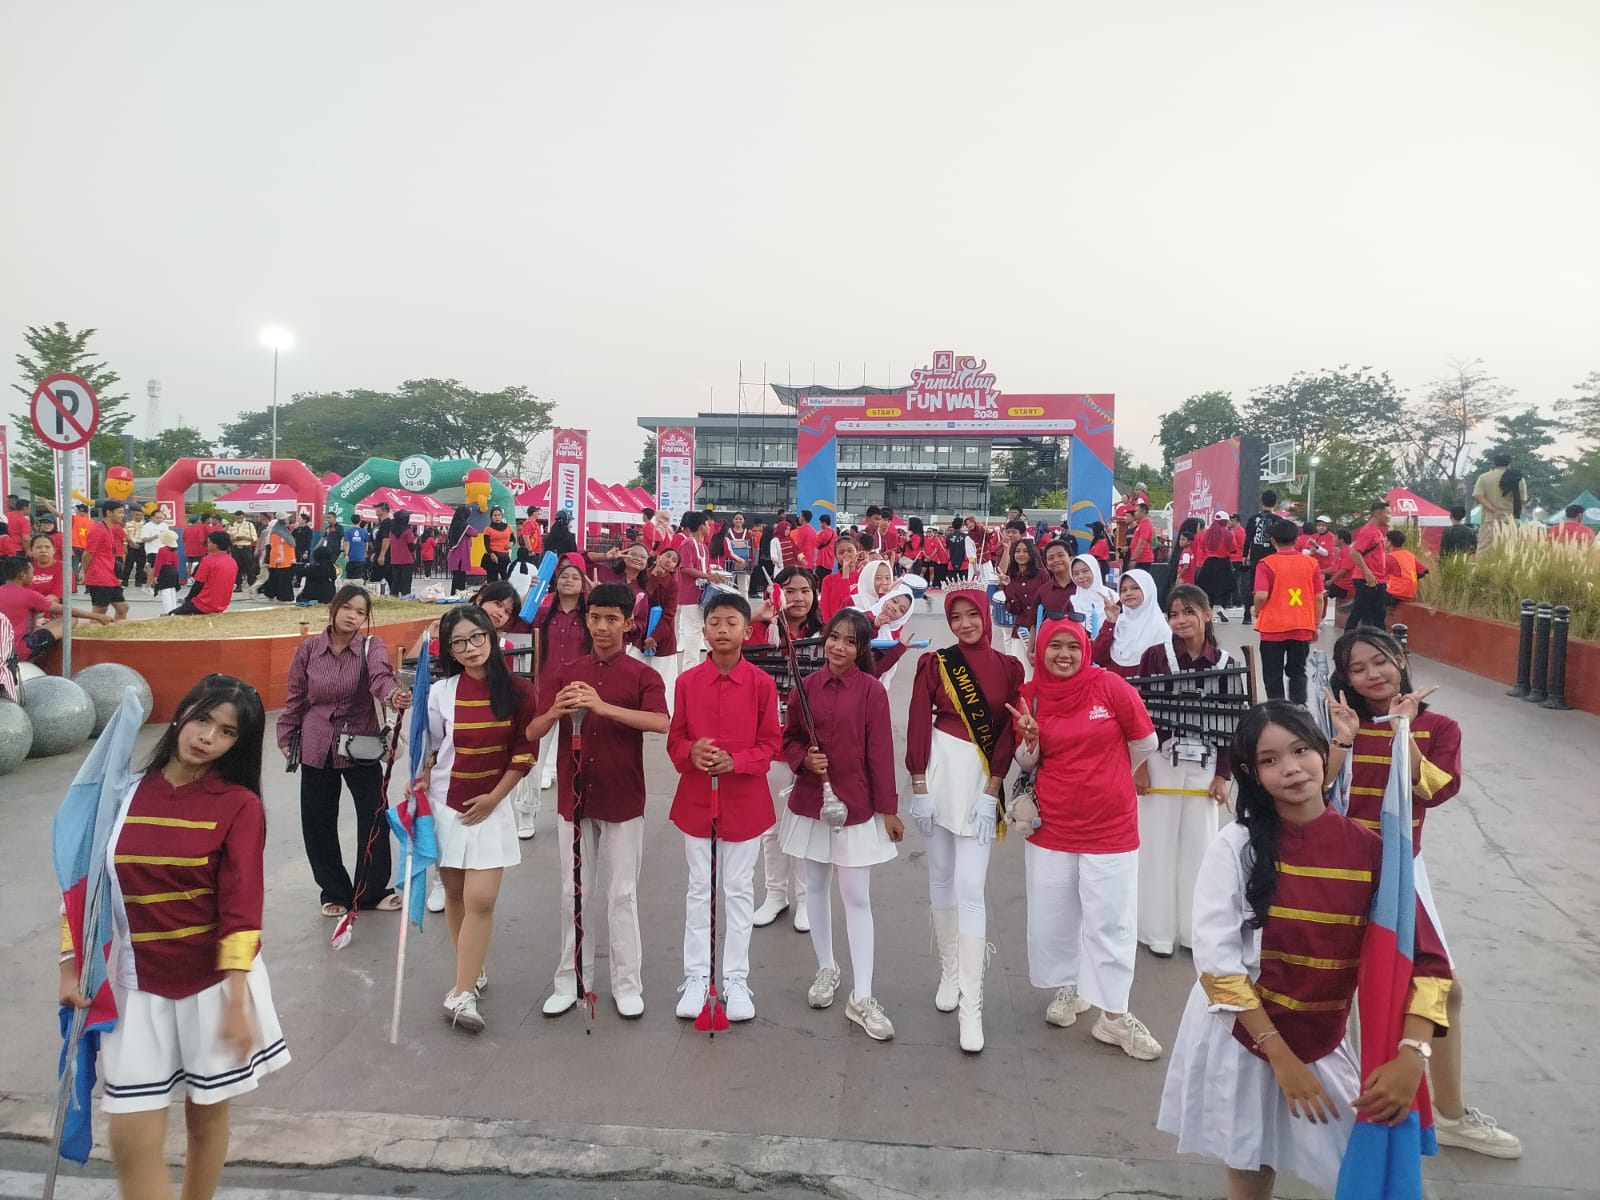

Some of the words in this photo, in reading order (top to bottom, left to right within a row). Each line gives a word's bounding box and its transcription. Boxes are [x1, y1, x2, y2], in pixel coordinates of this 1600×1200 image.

[906, 390, 942, 412] FUN
[945, 390, 1000, 412] WALK
[55, 389, 80, 435] P
[871, 408, 896, 416] START
[974, 410, 999, 419] 2026
[1013, 407, 1038, 416] START
[217, 465, 267, 476] Alfamidi
[340, 474, 371, 499] OPENING
[341, 472, 365, 491] GRAND
[953, 665, 980, 705] SMPN
[971, 709, 985, 721] 2
[976, 723, 994, 758] PALI
